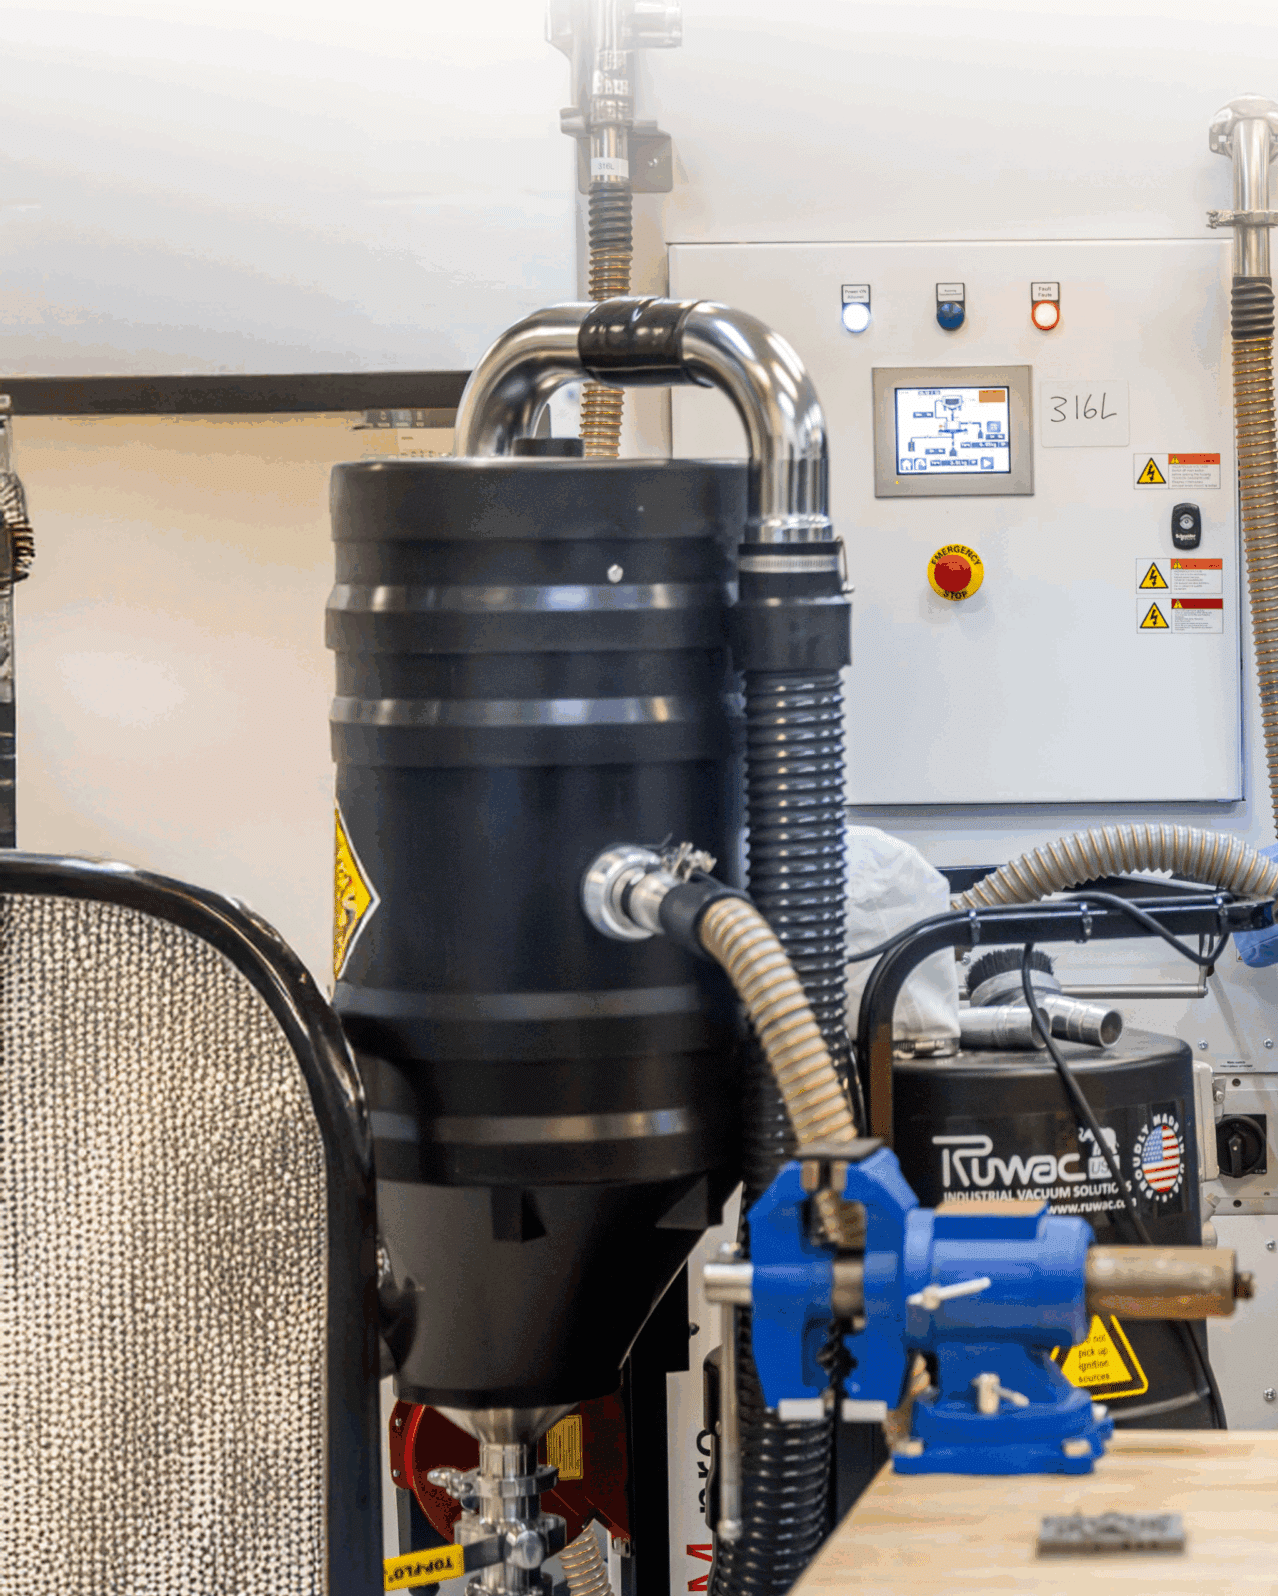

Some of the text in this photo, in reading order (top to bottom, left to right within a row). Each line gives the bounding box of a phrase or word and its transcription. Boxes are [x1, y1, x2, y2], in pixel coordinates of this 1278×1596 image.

[1050, 392, 1118, 423] 316L
[931, 545, 982, 566] EMERGENCY
[943, 590, 968, 600] STOP
[1153, 1113, 1180, 1133] MADE
[932, 1134, 1087, 1188] Ruwac
[943, 1180, 1132, 1202] INDUSTRIAL VACUUM SOLUTIOS
